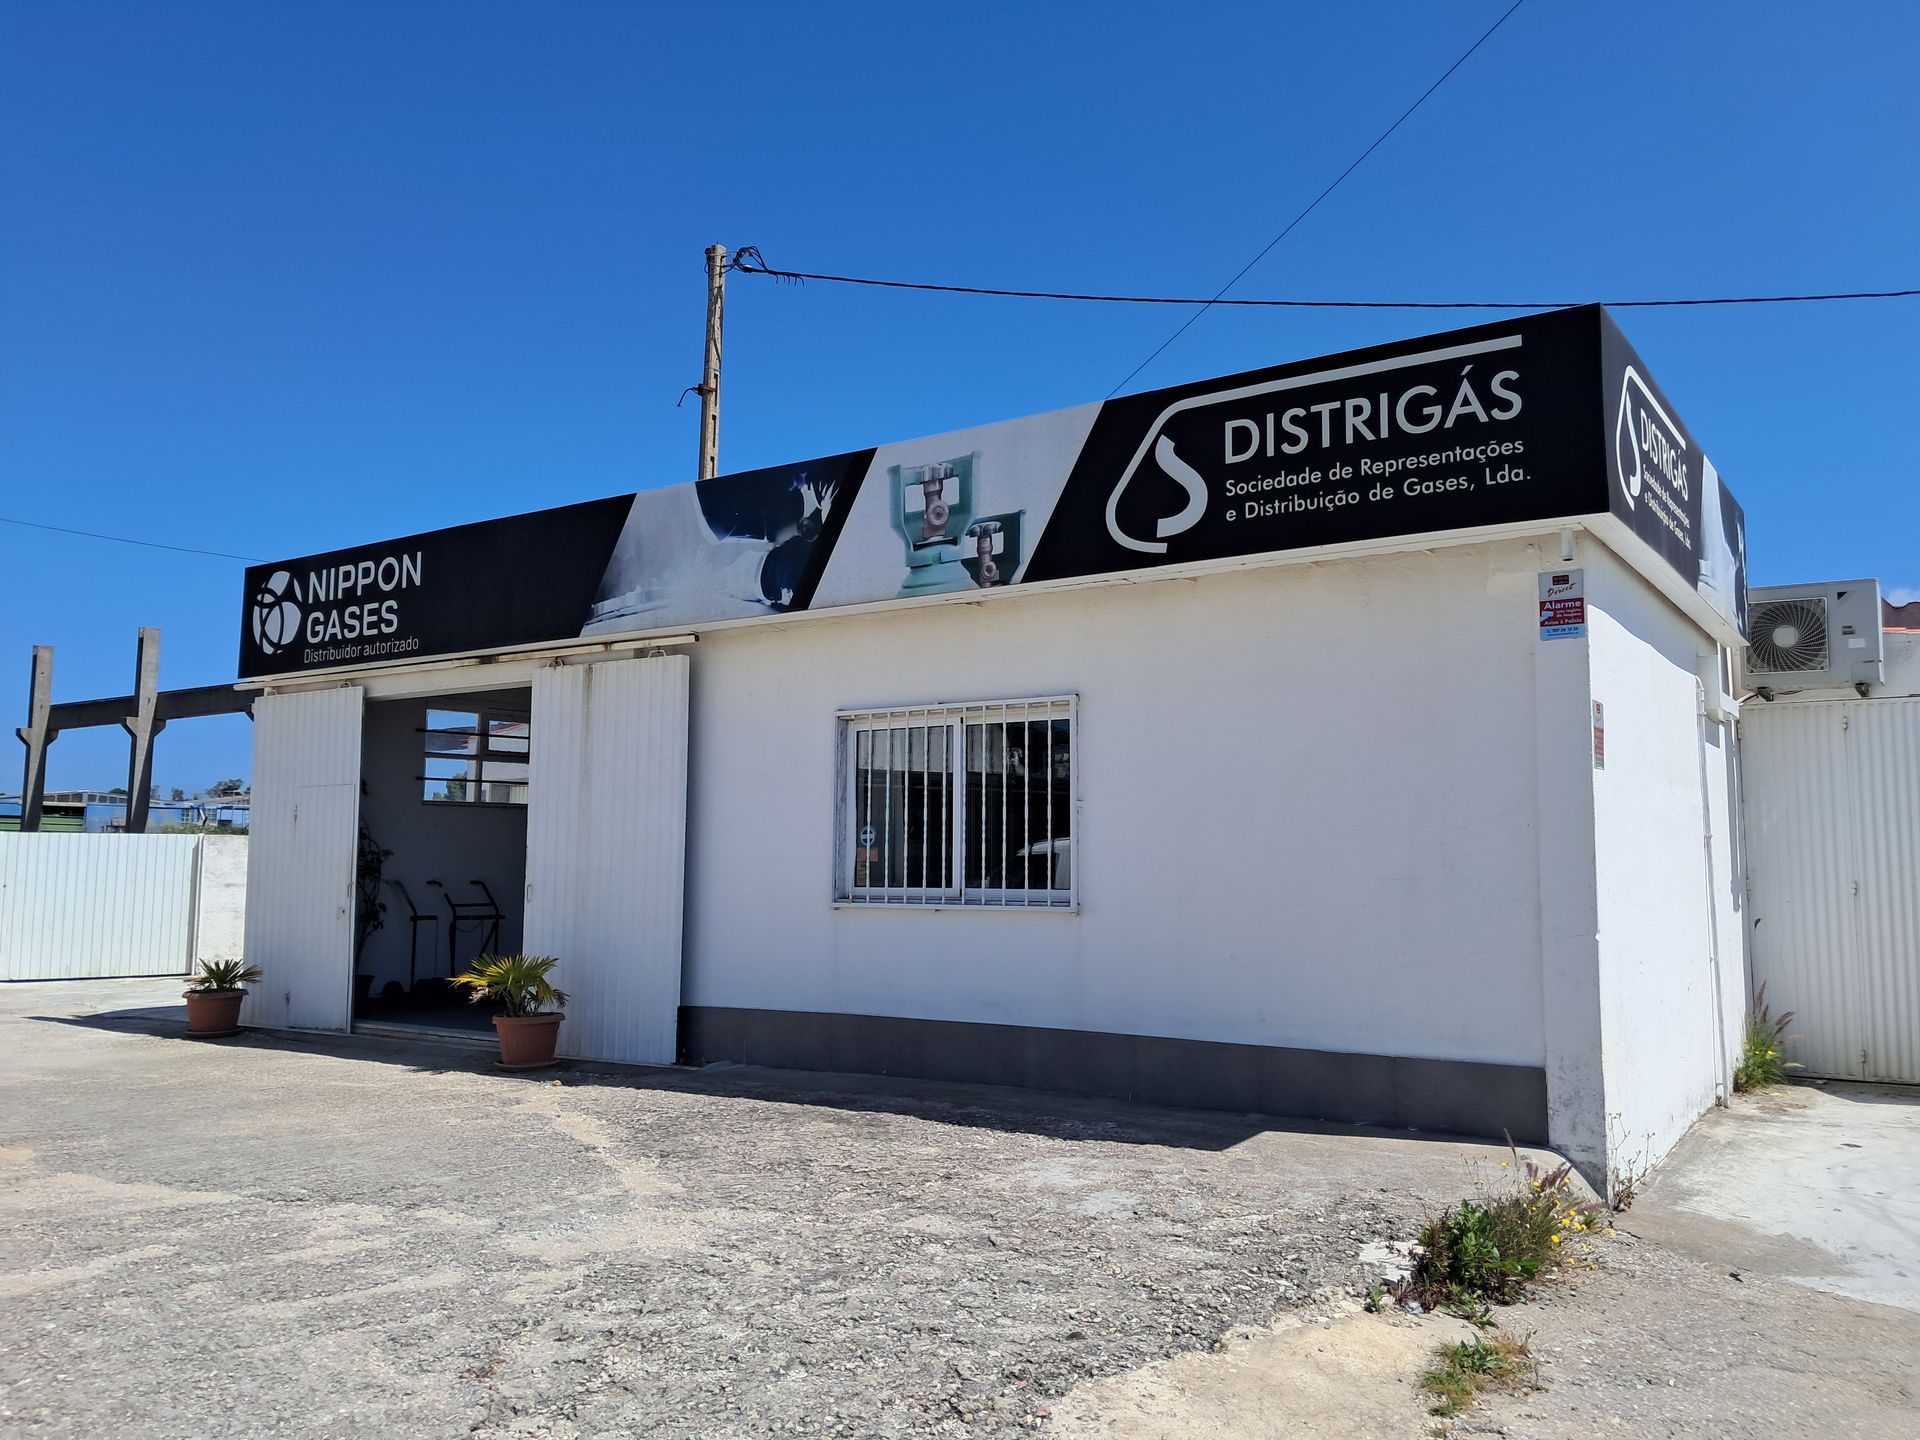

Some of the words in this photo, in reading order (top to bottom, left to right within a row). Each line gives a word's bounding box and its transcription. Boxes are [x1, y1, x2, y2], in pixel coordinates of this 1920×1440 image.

[1225, 365, 1522, 464] DISTRIGÁS
[1226, 466, 1322, 497] Sociedade
[1329, 462, 1353, 481] de
[1360, 440, 1524, 477] Representações
[1640, 408, 1689, 501] DISTRIGÁS
[1226, 509, 1237, 521] e
[1245, 490, 1360, 520] Distribuição
[1369, 482, 1394, 501] de
[1403, 476, 1475, 497] Gases,
[1485, 464, 1531, 486] Lda.
[308, 551, 422, 604] NIPPON
[1544, 600, 1582, 610] Alarme
[306, 600, 399, 644] GASES
[304, 644, 361, 664] Distribuidor
[363, 636, 419, 655] autorizado
